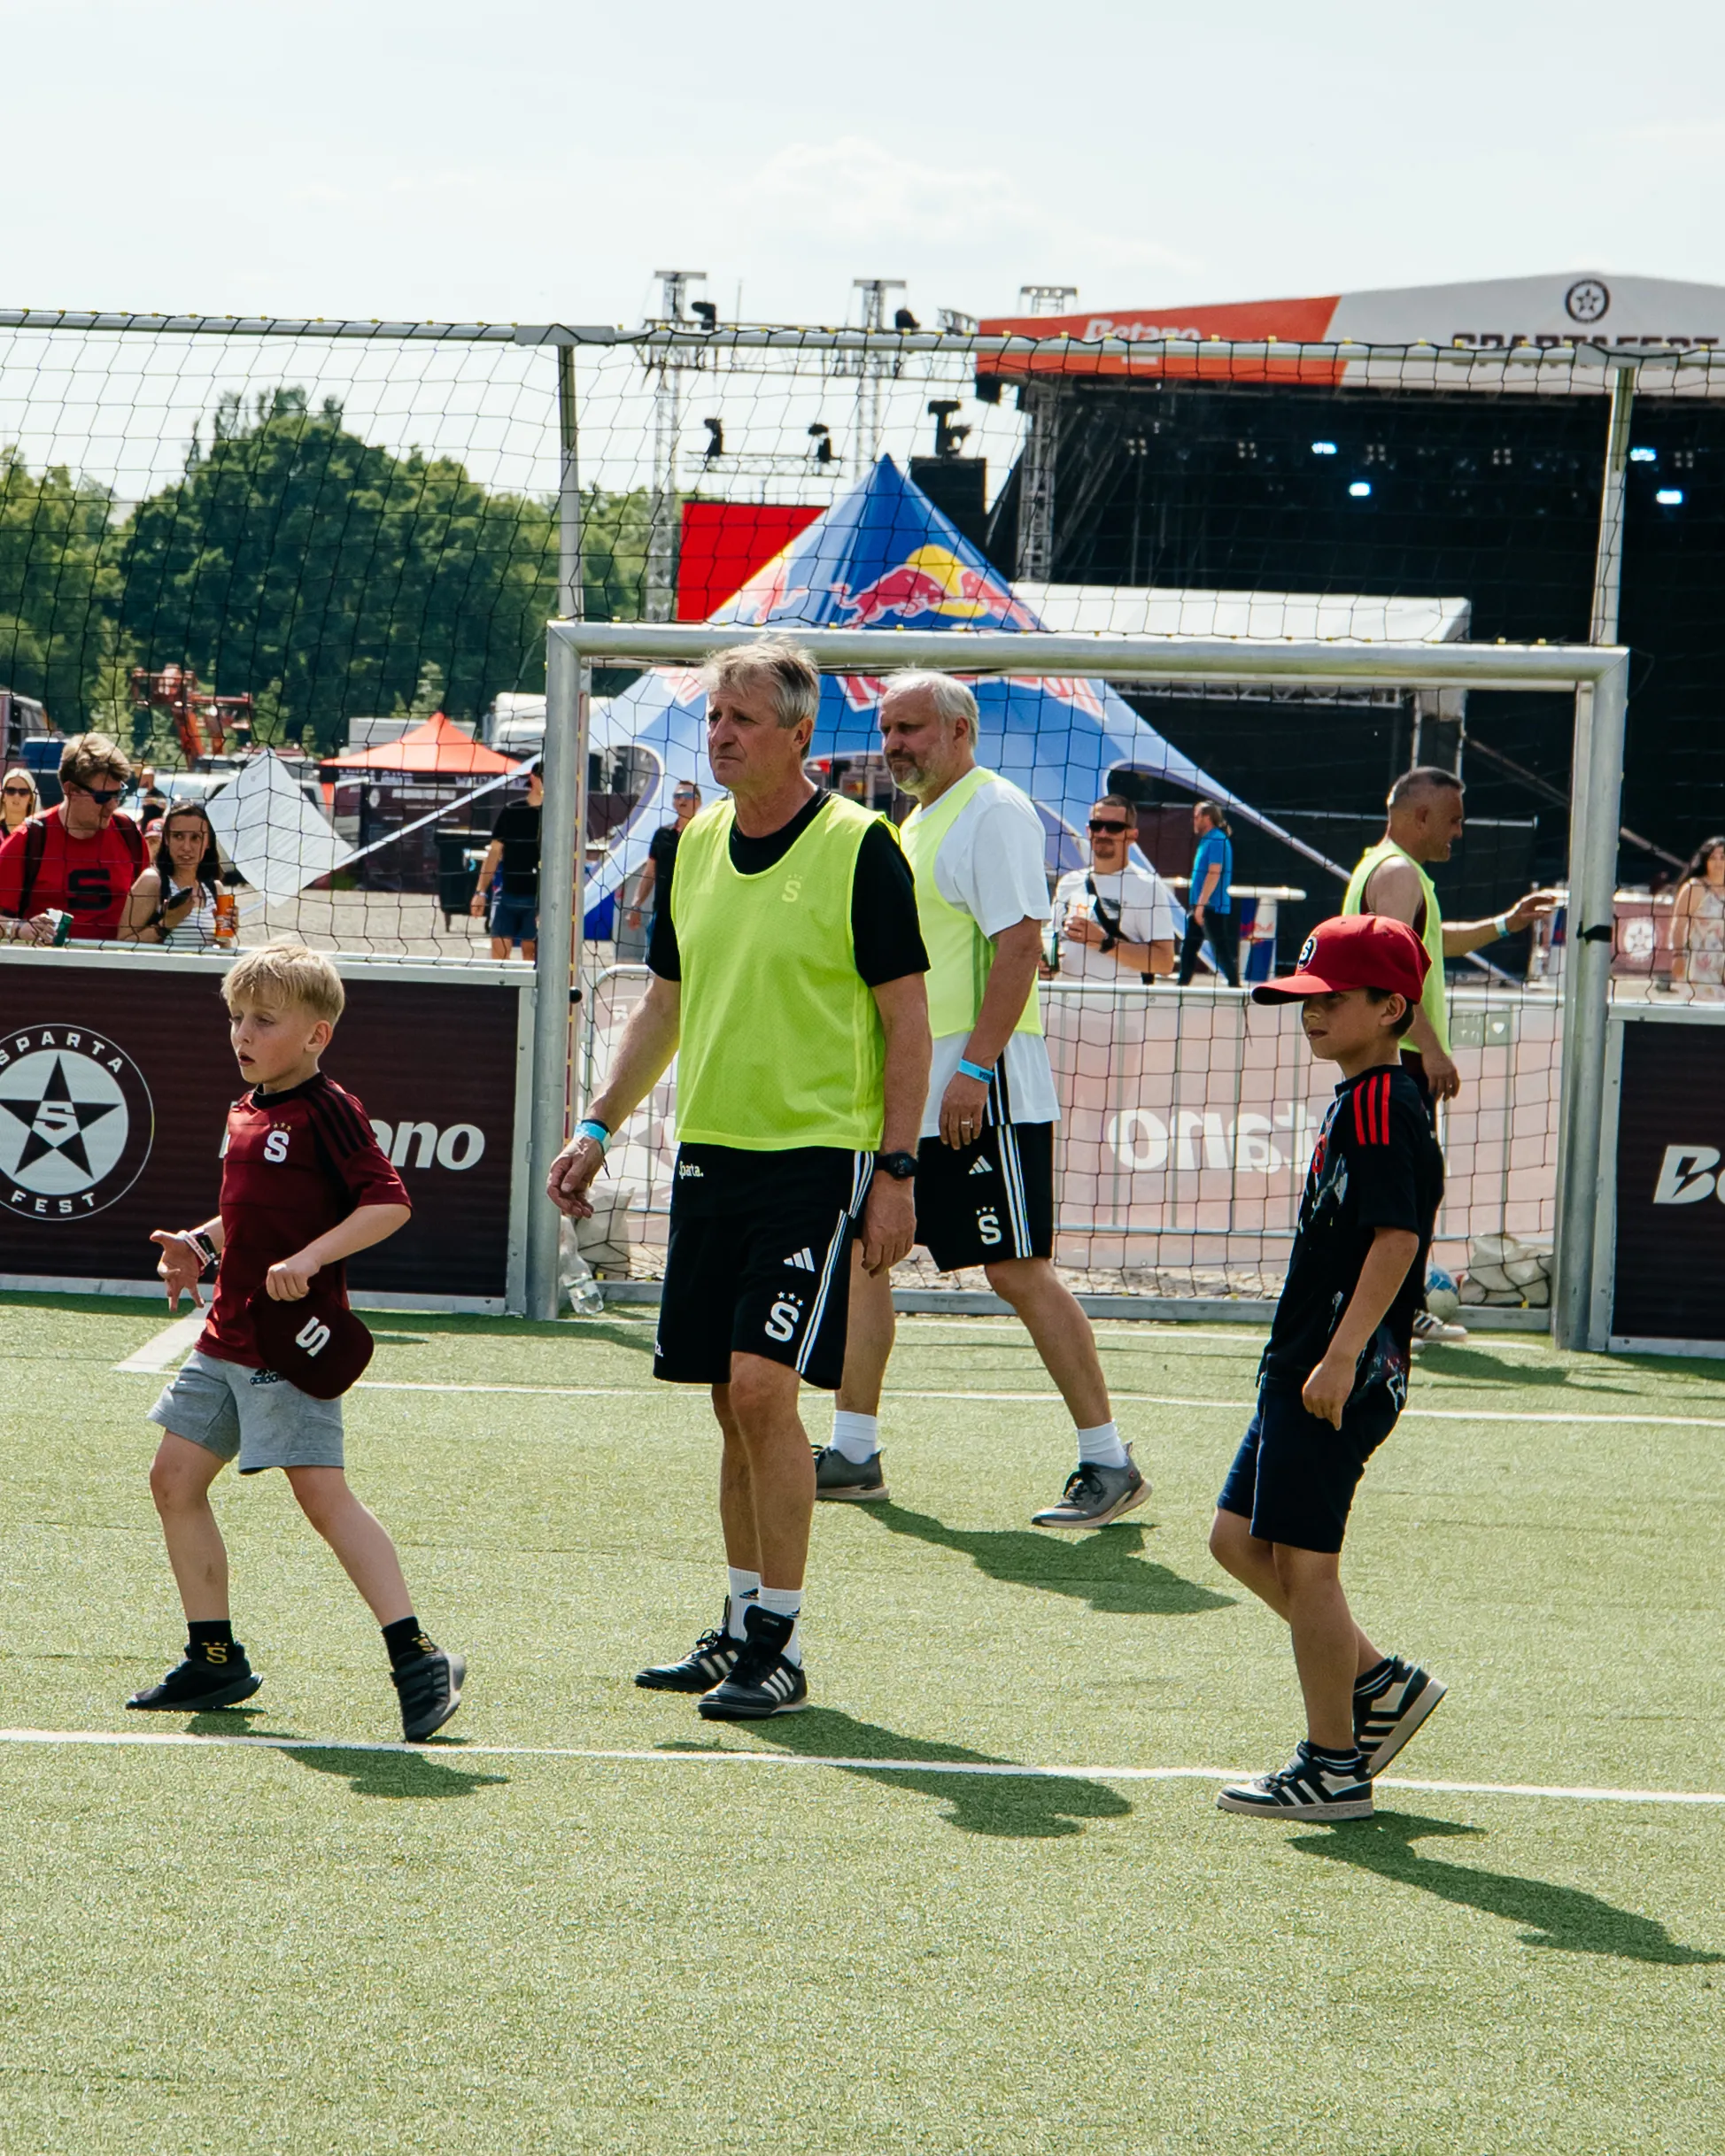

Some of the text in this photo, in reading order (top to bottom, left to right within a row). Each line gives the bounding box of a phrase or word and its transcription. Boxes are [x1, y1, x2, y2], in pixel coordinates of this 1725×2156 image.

[67, 869, 112, 910] S
[782, 879, 801, 902] S
[0, 1031, 123, 1073] SPARTA
[264, 1131, 290, 1163] S
[1653, 1144, 1725, 1205] B
[11, 1190, 96, 1213] FEST
[978, 1215, 1002, 1245] S
[295, 1316, 330, 1357] S
[764, 1301, 800, 1342] S
[205, 1646, 228, 1665] S
